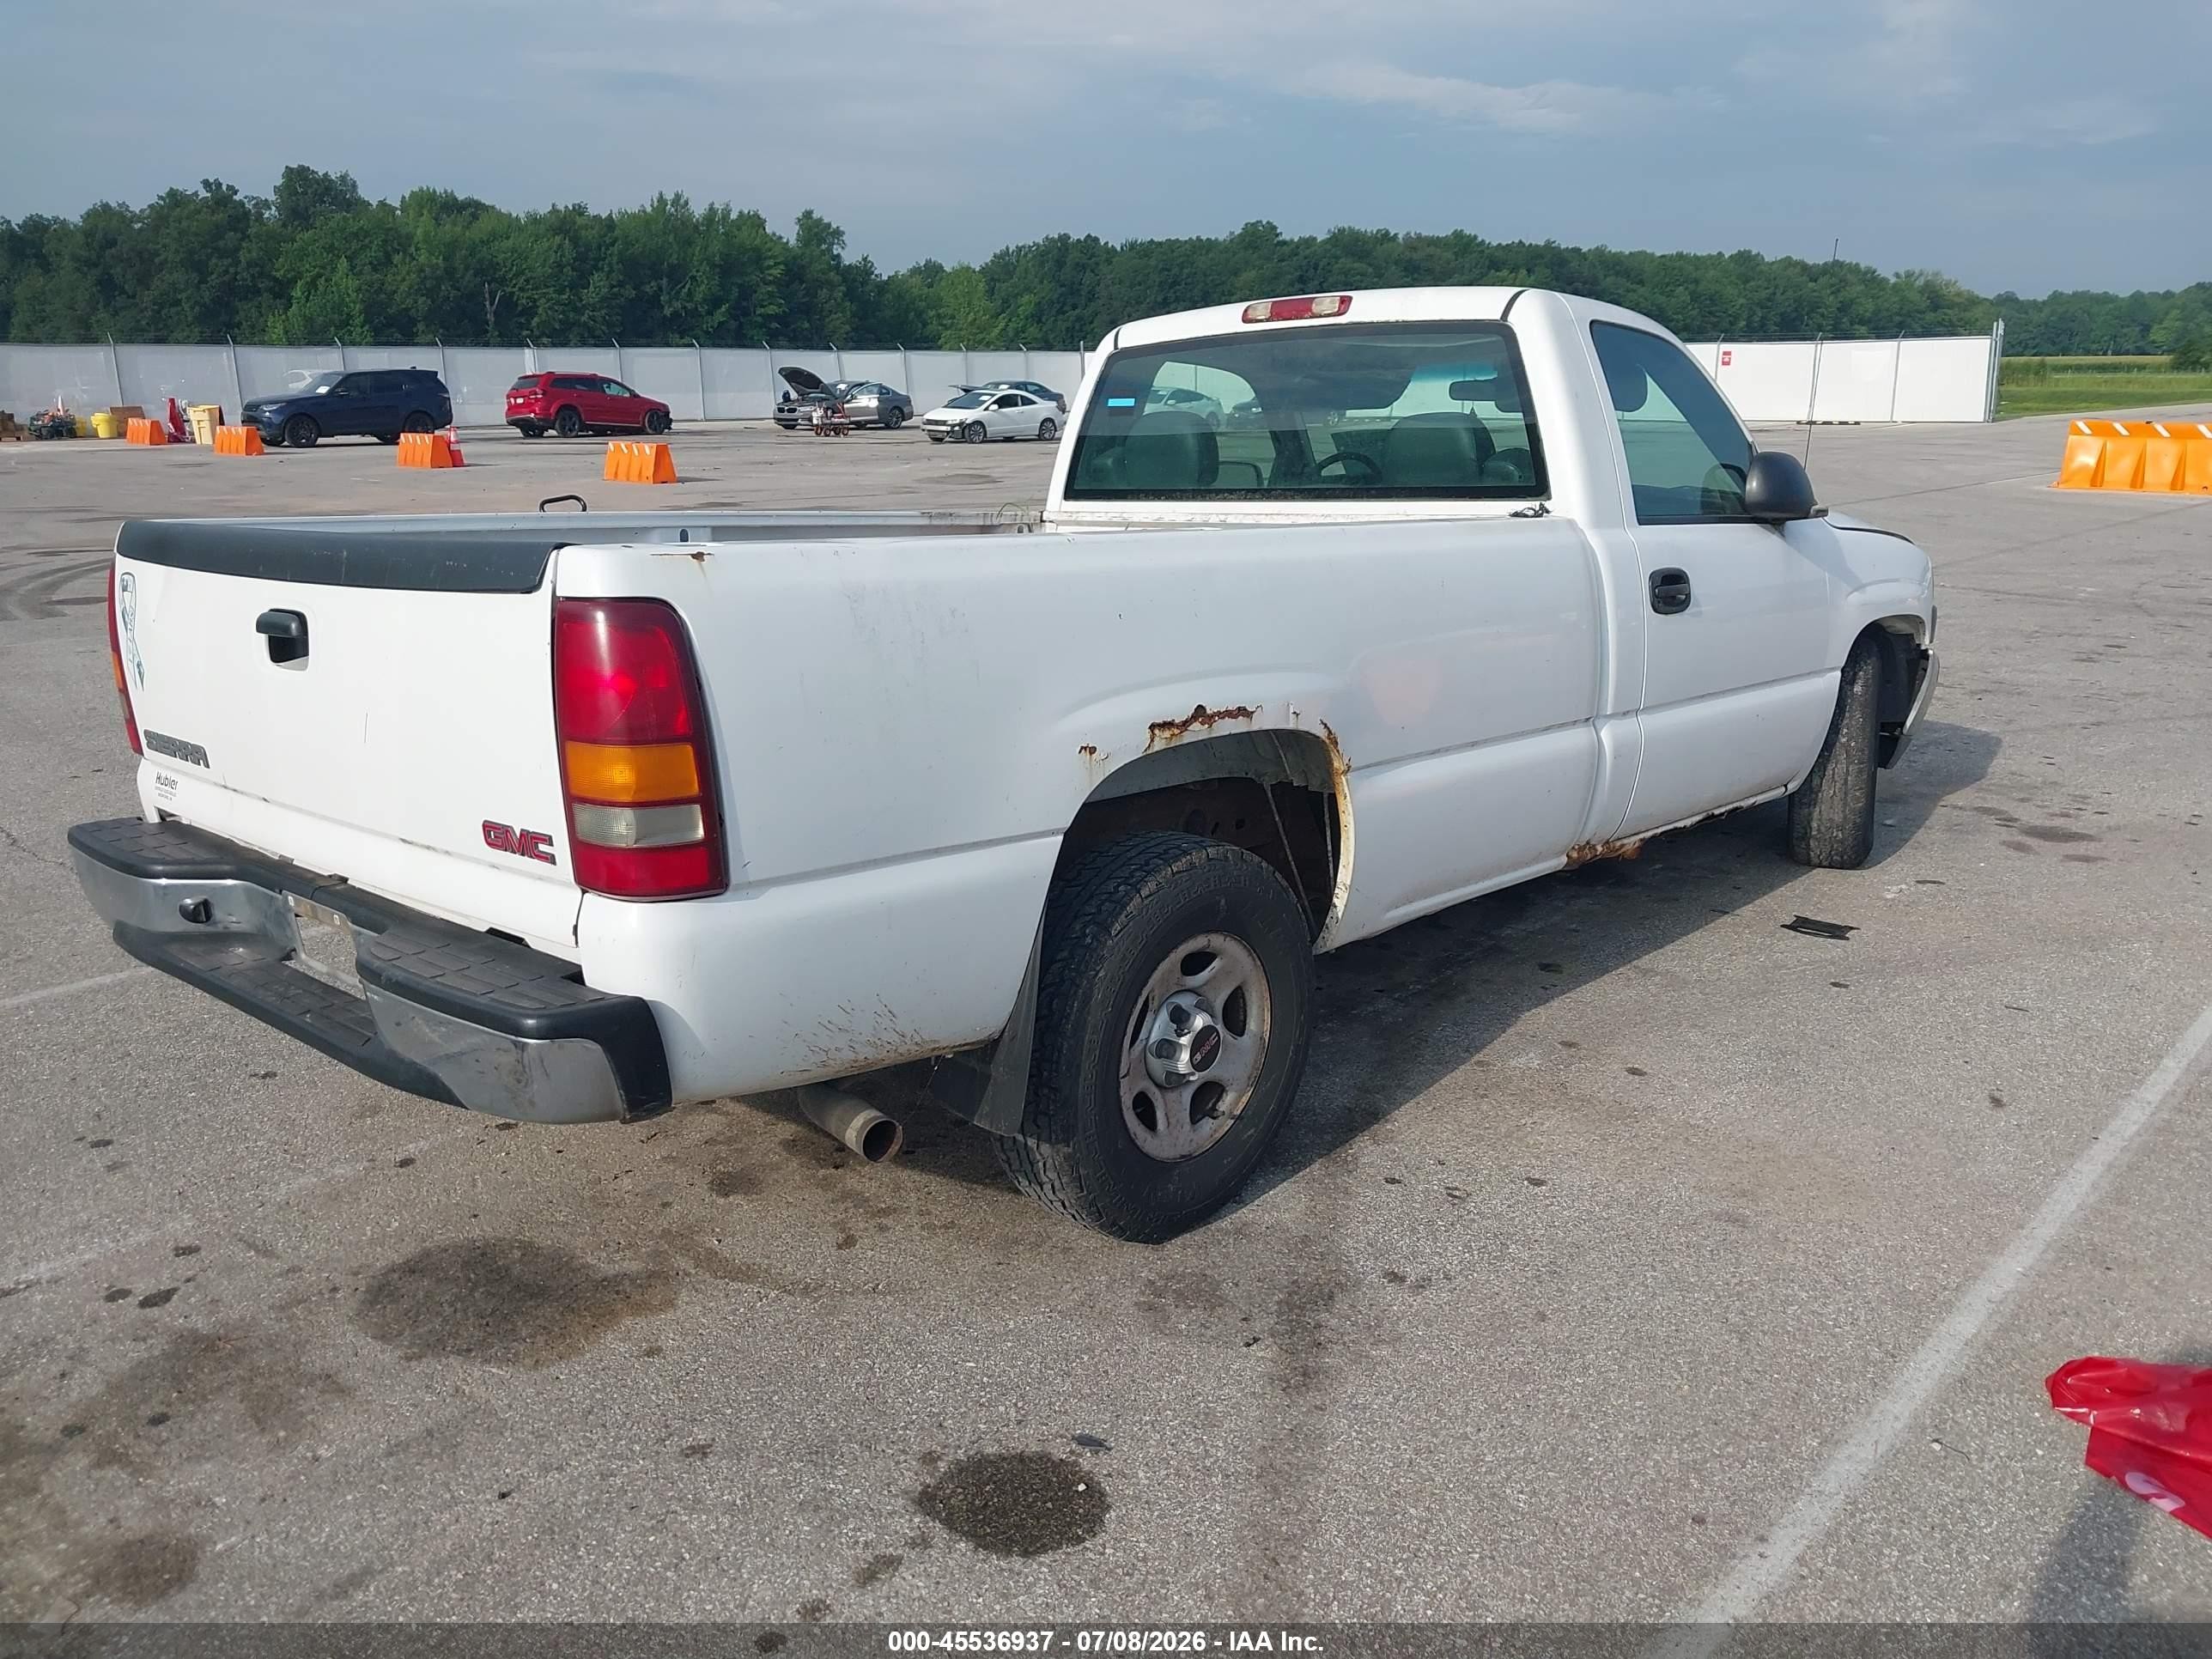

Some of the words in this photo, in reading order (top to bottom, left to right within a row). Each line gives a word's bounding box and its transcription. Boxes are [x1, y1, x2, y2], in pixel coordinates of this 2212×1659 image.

[143, 729, 210, 769] SIERRA
[155, 771, 179, 791] Hubler
[482, 819, 556, 866] GMC
[1193, 1032, 1218, 1065] GMC
